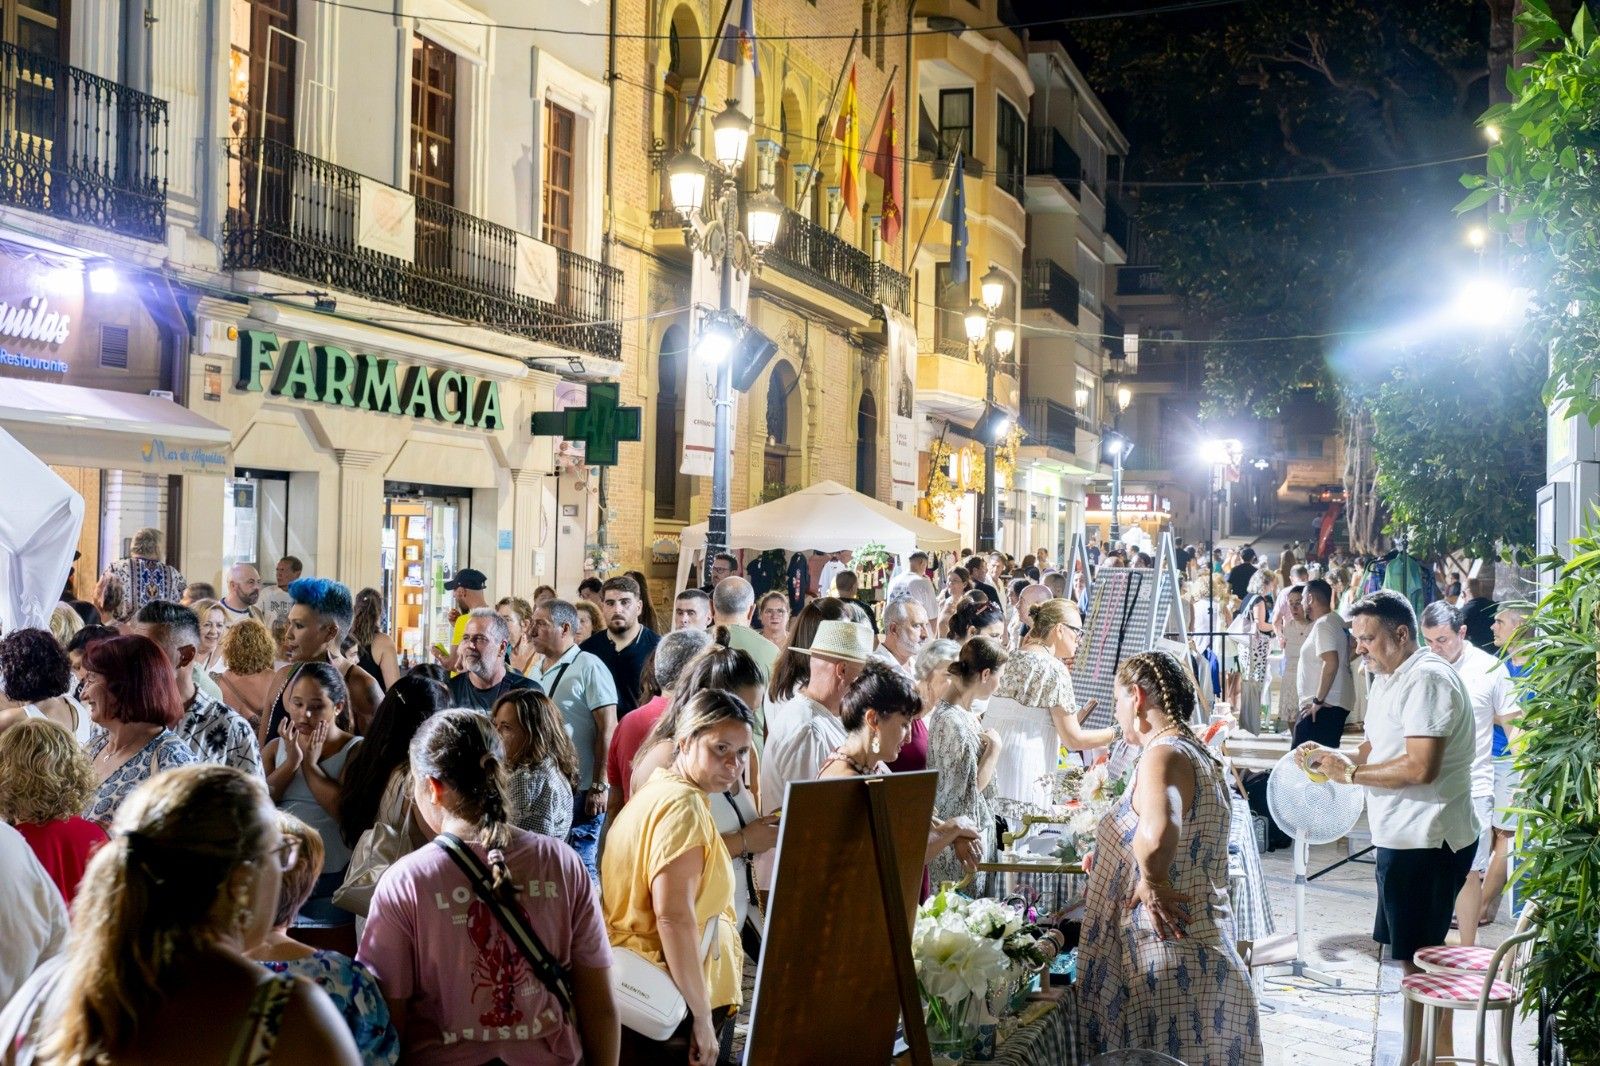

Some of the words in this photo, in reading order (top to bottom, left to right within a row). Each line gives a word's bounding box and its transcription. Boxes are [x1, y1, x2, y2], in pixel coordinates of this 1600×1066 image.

[0, 296, 70, 344] uilas
[0, 348, 69, 373] Restaurante
[239, 330, 504, 430] FARMACIA
